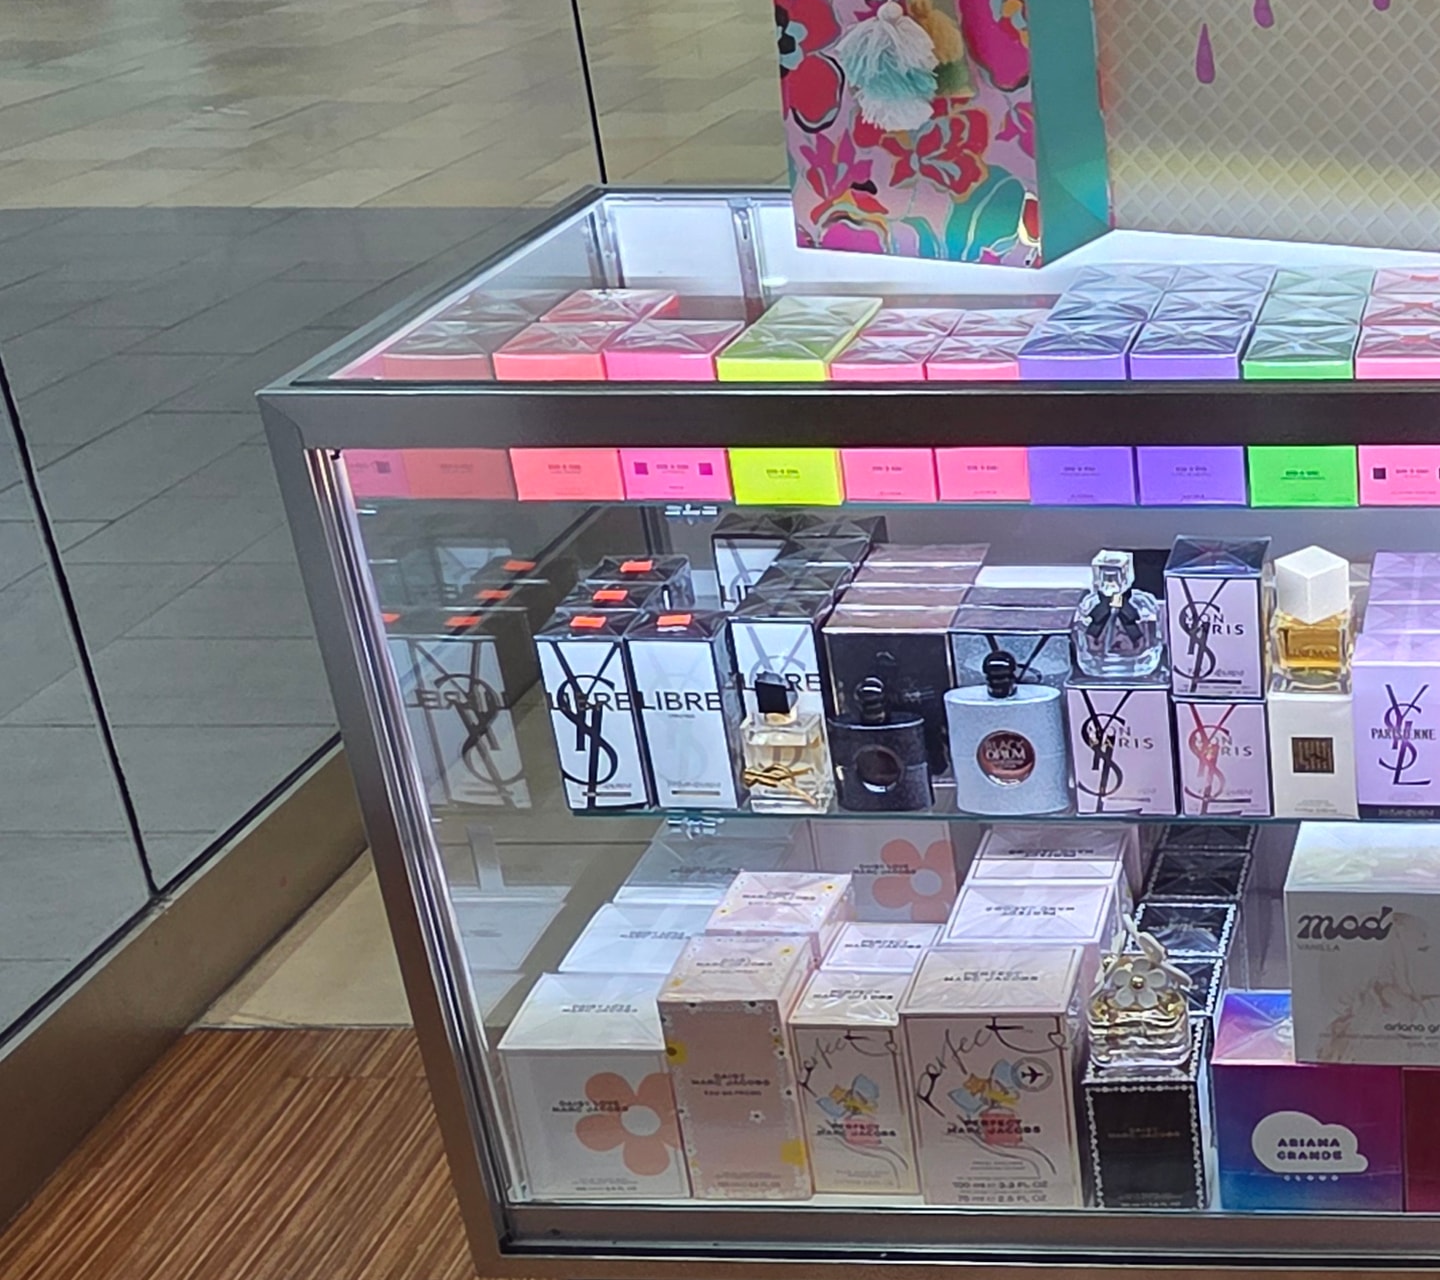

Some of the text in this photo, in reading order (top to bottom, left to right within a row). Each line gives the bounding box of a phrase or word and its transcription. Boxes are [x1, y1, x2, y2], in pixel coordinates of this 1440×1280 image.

[638, 691, 722, 712] LIBRE
[985, 738, 1025, 750] BLACK
[984, 749, 1027, 761] OPIUM
[1297, 906, 1394, 941] mod
[1297, 944, 1341, 952] VANILLA
[1383, 1023, 1425, 1033] ariana
[1277, 1137, 1341, 1148] ARIANA
[1276, 1150, 1343, 1161] GRANDE
